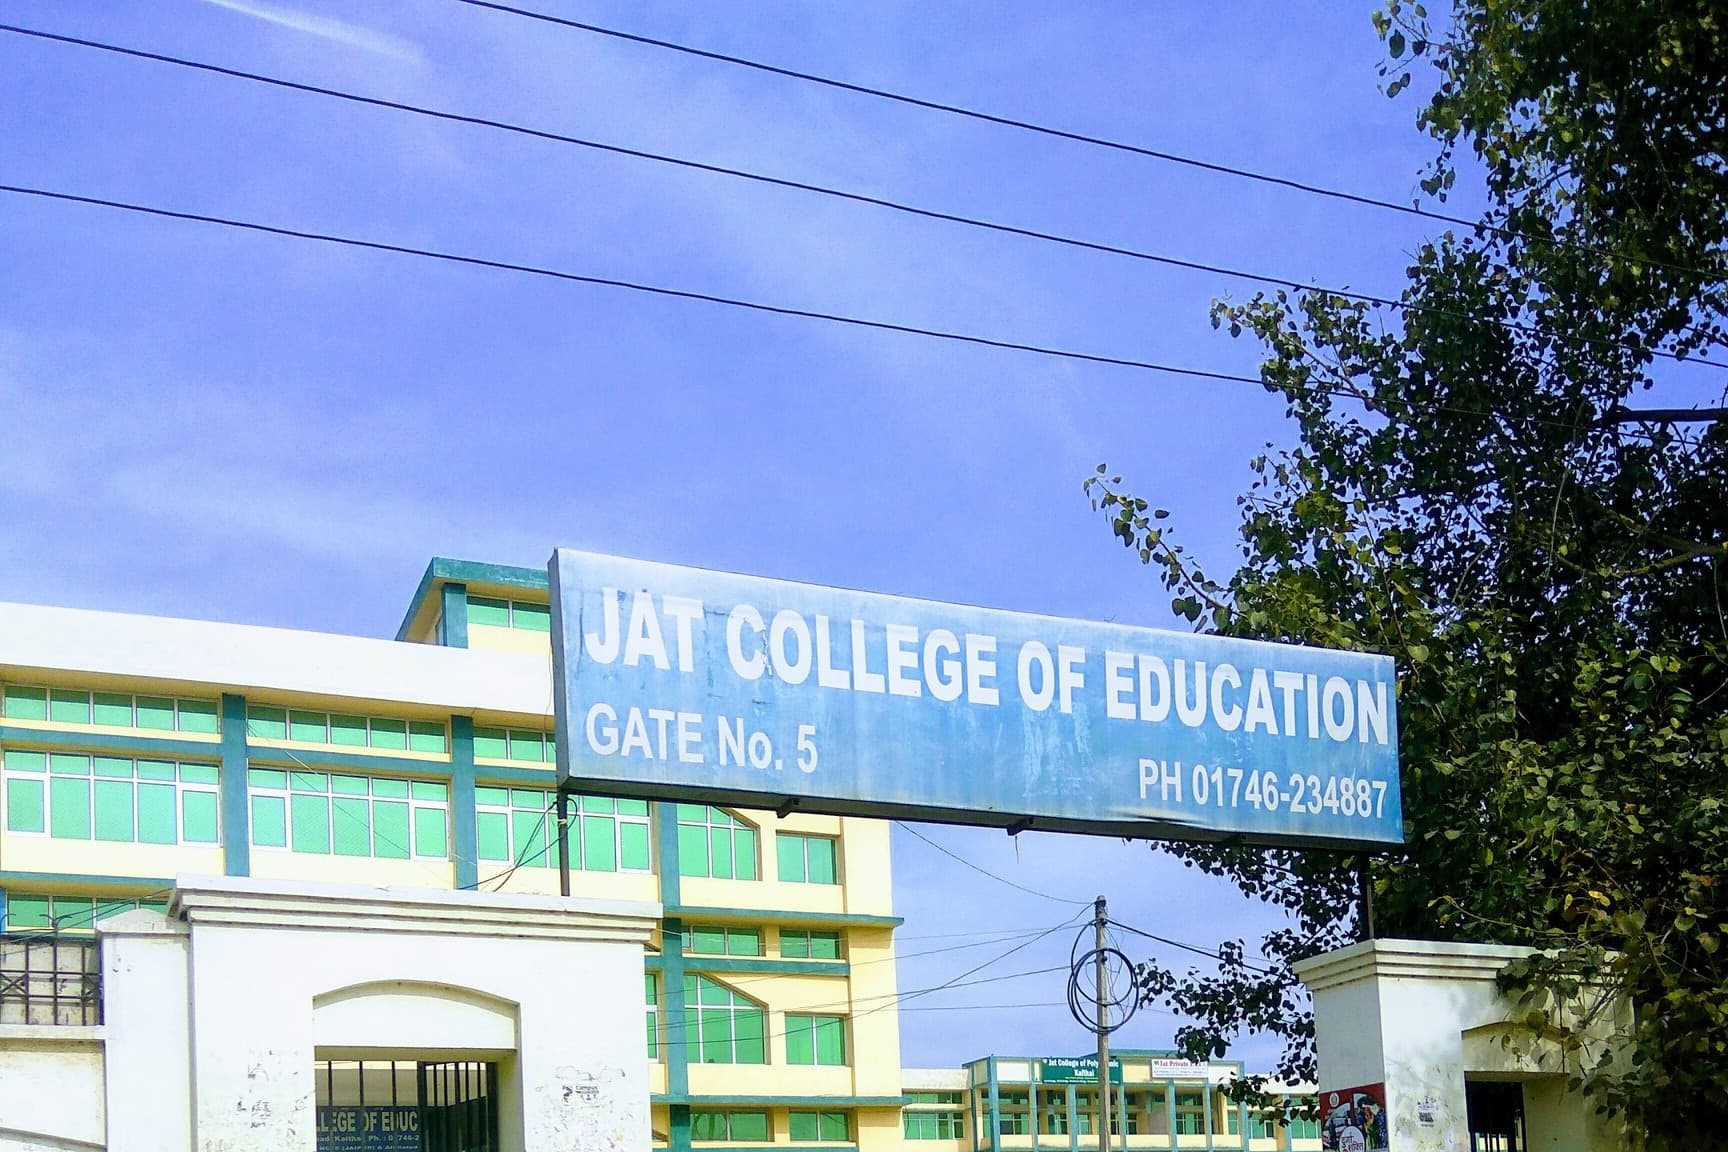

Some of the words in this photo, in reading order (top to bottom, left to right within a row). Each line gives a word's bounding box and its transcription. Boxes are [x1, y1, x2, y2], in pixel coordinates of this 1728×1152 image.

[585, 586, 705, 674] JAT
[725, 603, 1000, 707] COLLEGE
[1016, 640, 1088, 714] OF
[1104, 649, 1390, 745] EDUCATION
[585, 702, 703, 764] GATE
[717, 716, 784, 770] No.
[795, 723, 819, 773] 5
[1138, 758, 1184, 804] PH
[1190, 765, 1388, 819] 01746-234887
